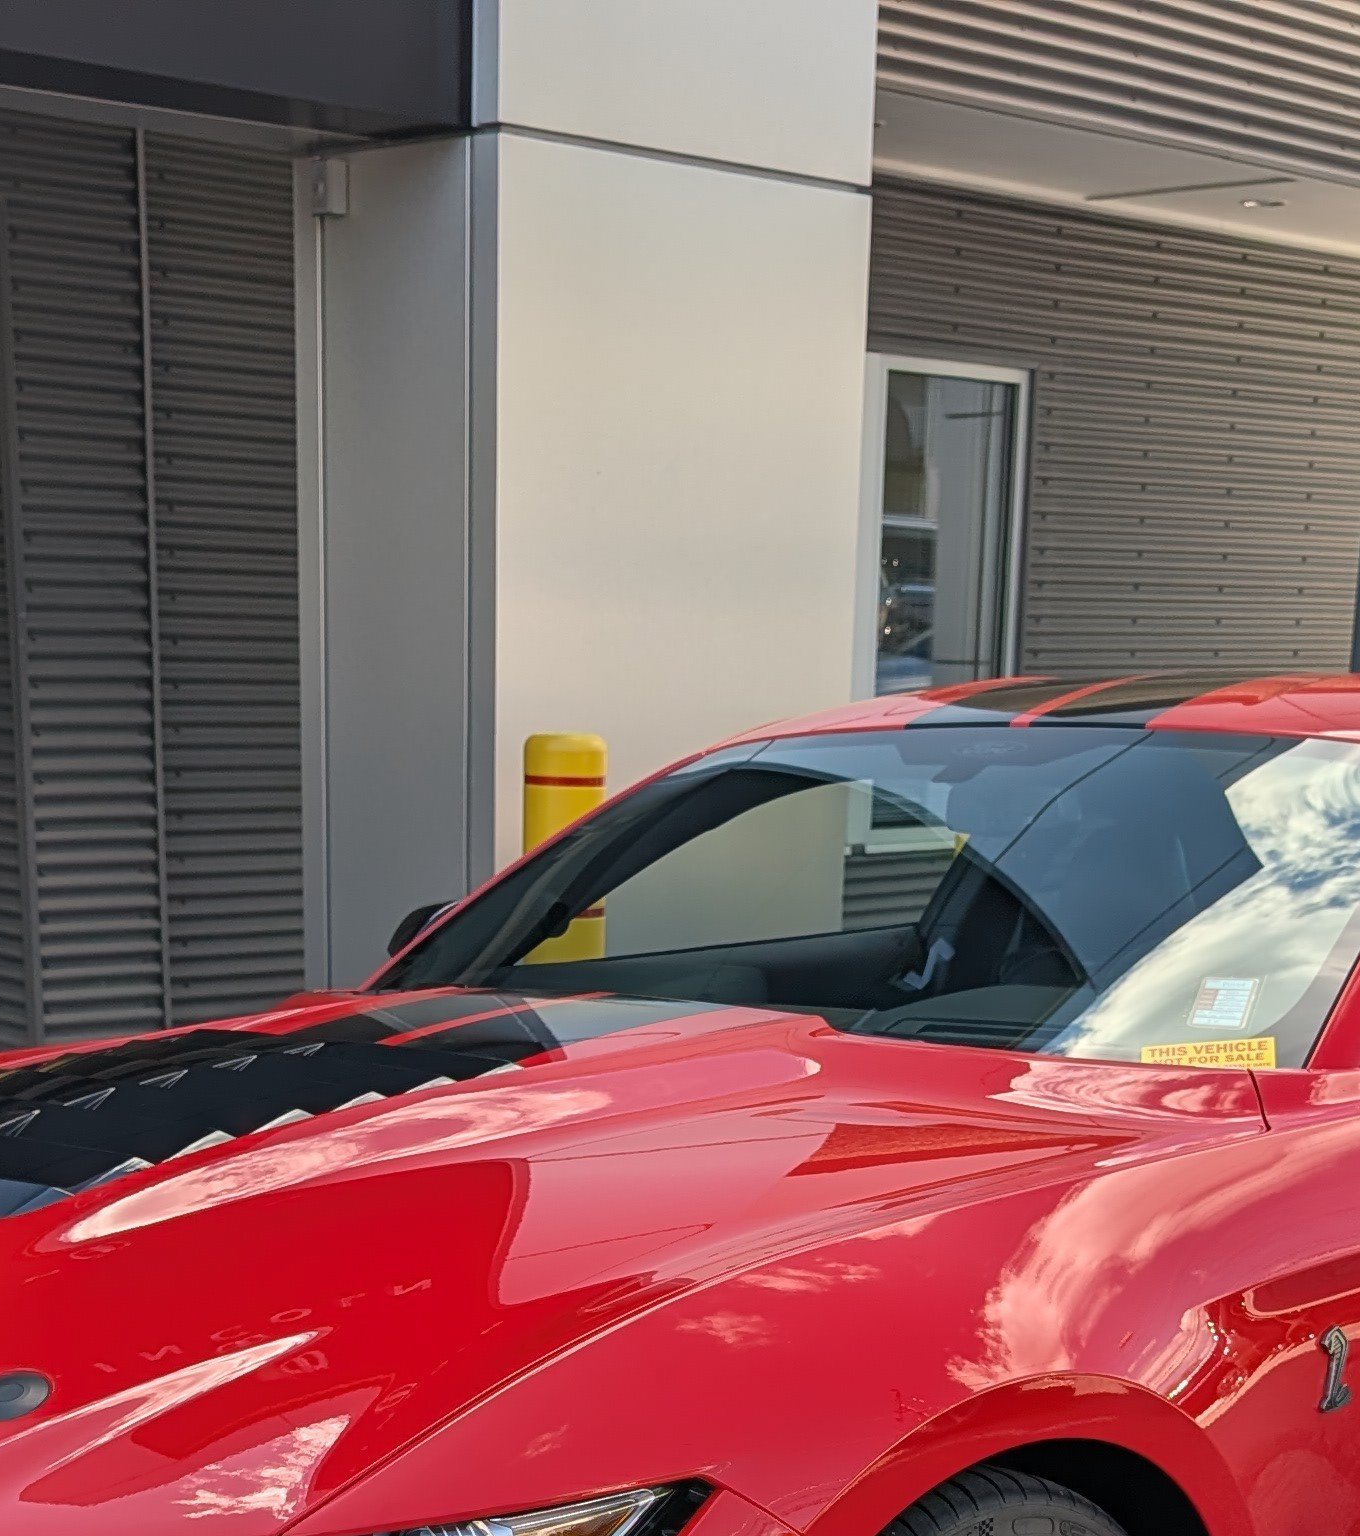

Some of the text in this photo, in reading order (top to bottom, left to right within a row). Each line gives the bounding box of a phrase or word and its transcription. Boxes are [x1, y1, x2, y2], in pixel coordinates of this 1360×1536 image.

[1148, 1040, 1269, 1058] THIS VEHICLE
[1152, 1052, 1265, 1065] NOT FOR SALE
